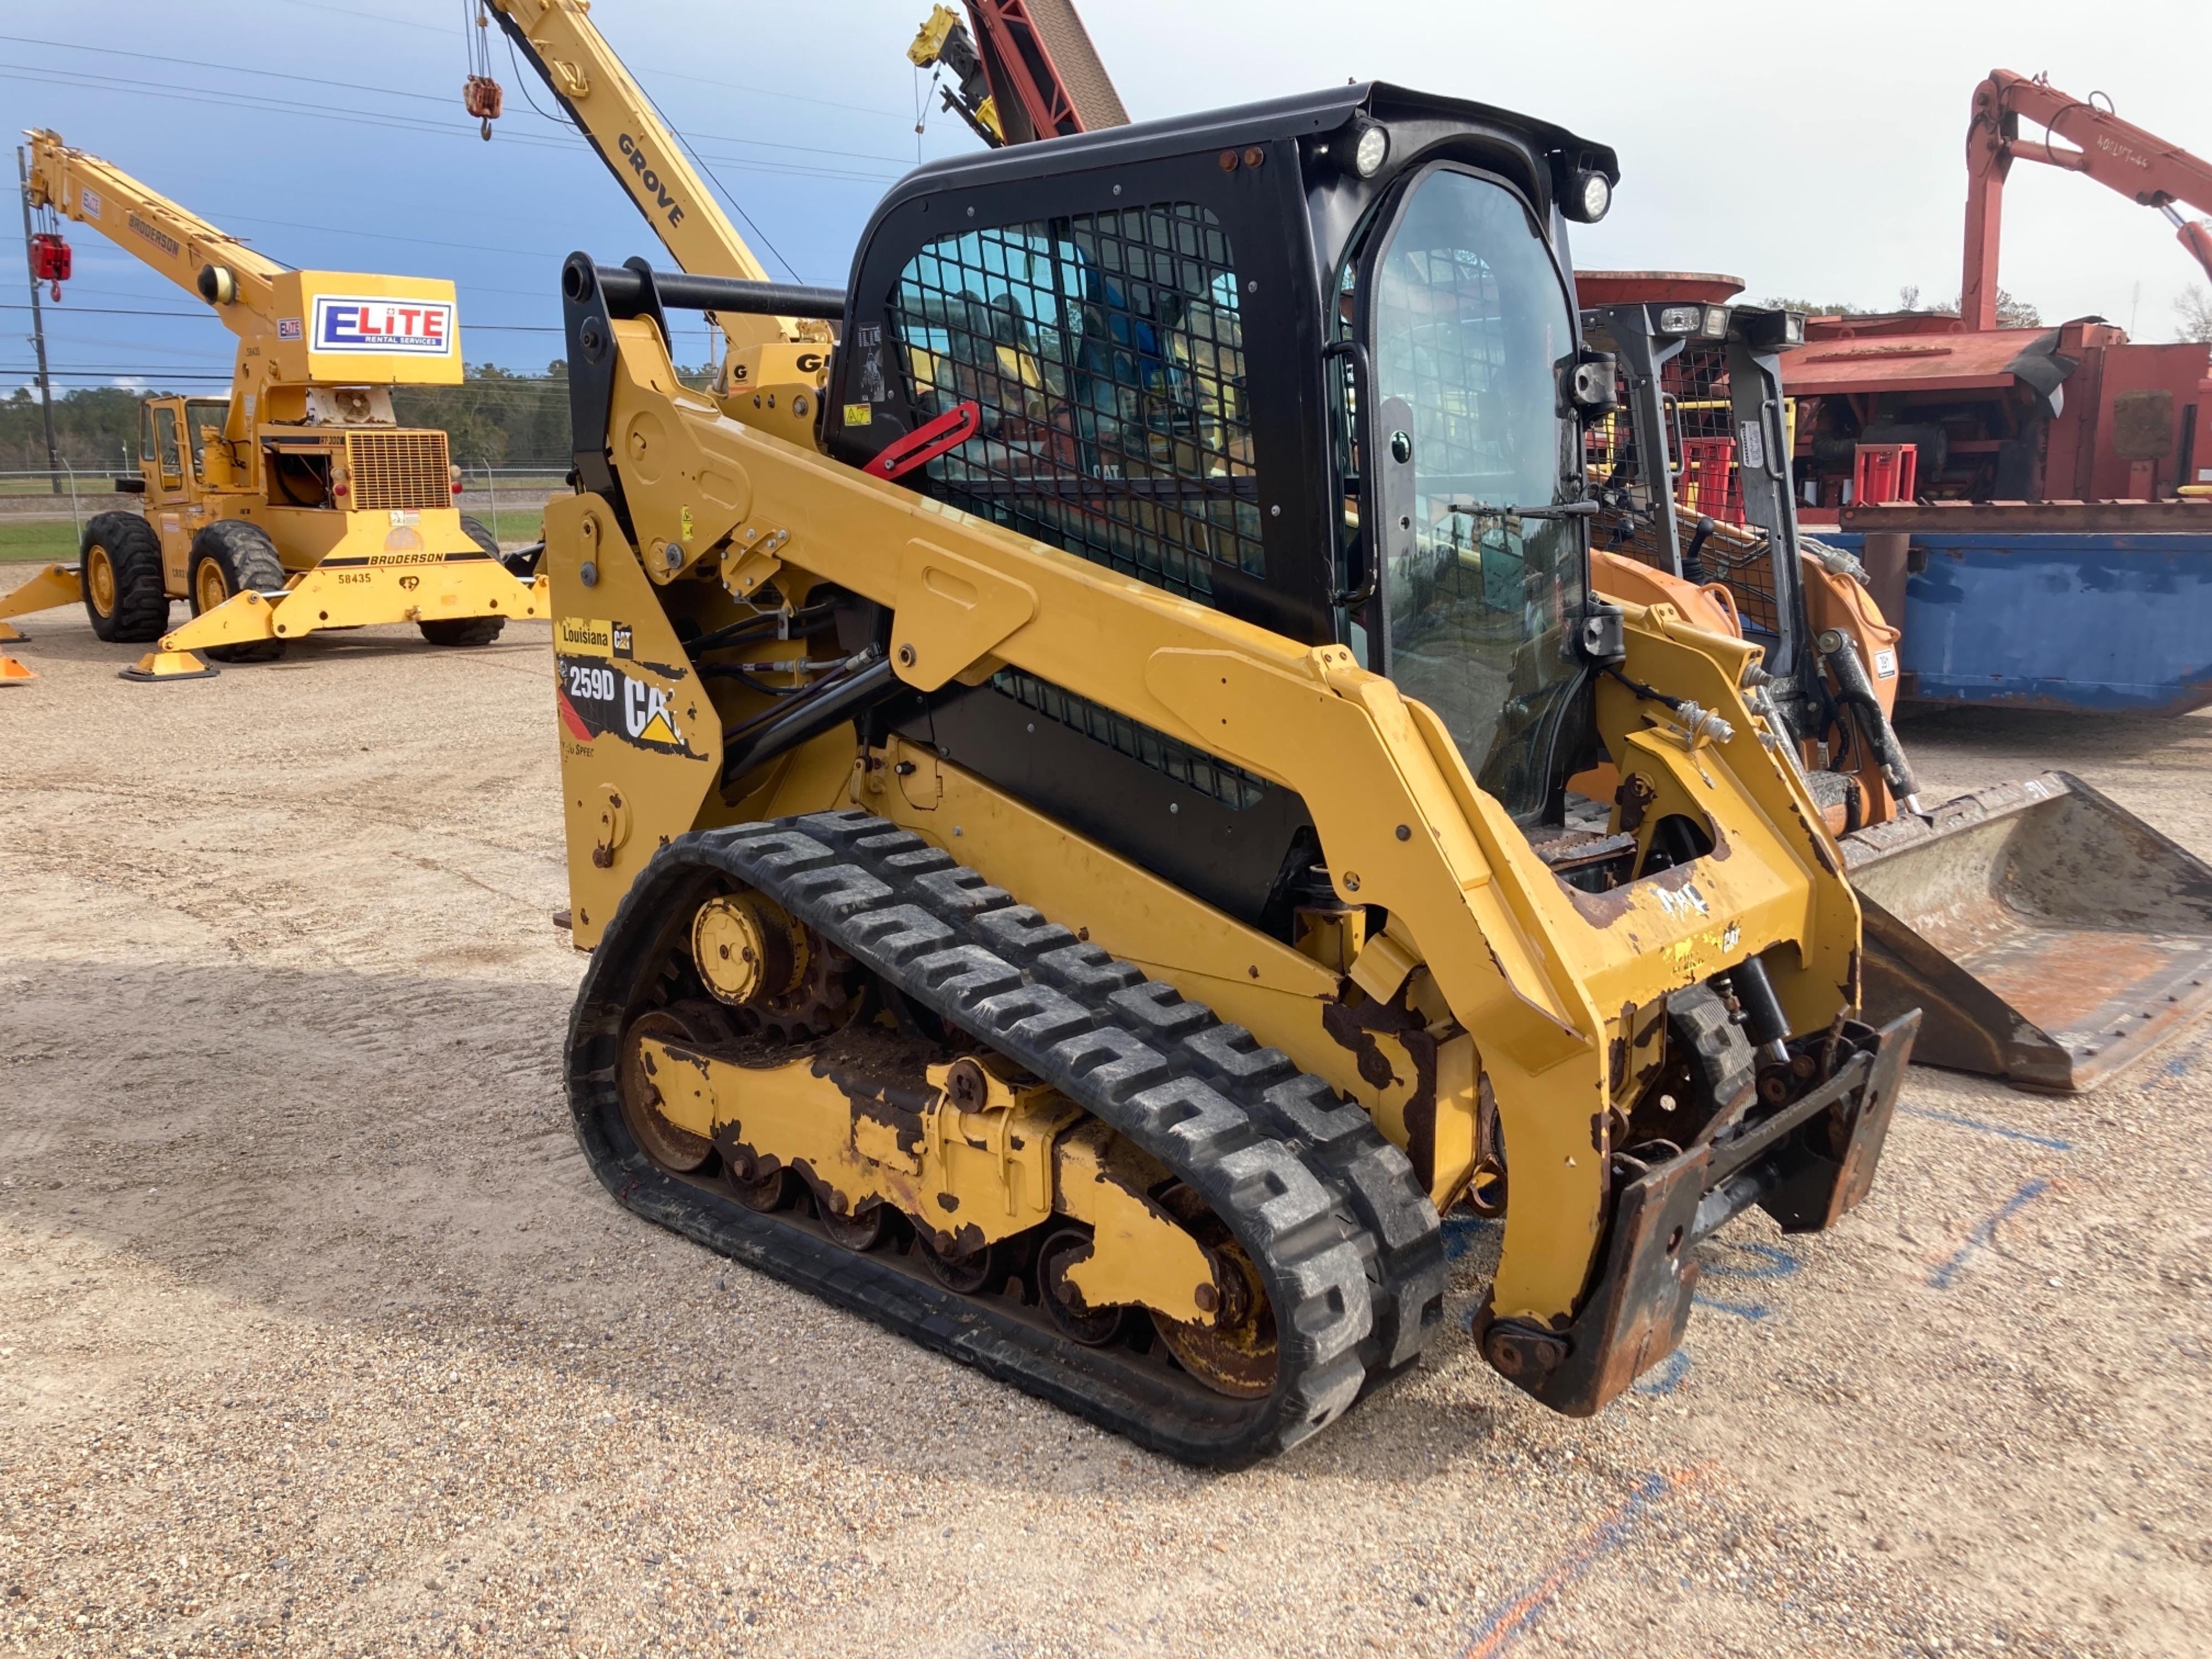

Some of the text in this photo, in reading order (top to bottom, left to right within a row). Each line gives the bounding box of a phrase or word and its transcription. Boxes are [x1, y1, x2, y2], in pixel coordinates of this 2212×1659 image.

[618, 133, 685, 229] GROVE
[128, 214, 179, 257] BRODERSON
[365, 336, 436, 345] RENTAL SERVICES
[370, 554, 444, 565] BRODERSON
[338, 573, 371, 585] 58435
[563, 625, 608, 646] Louisiana
[570, 666, 615, 701] 259D
[624, 676, 685, 745] CA
